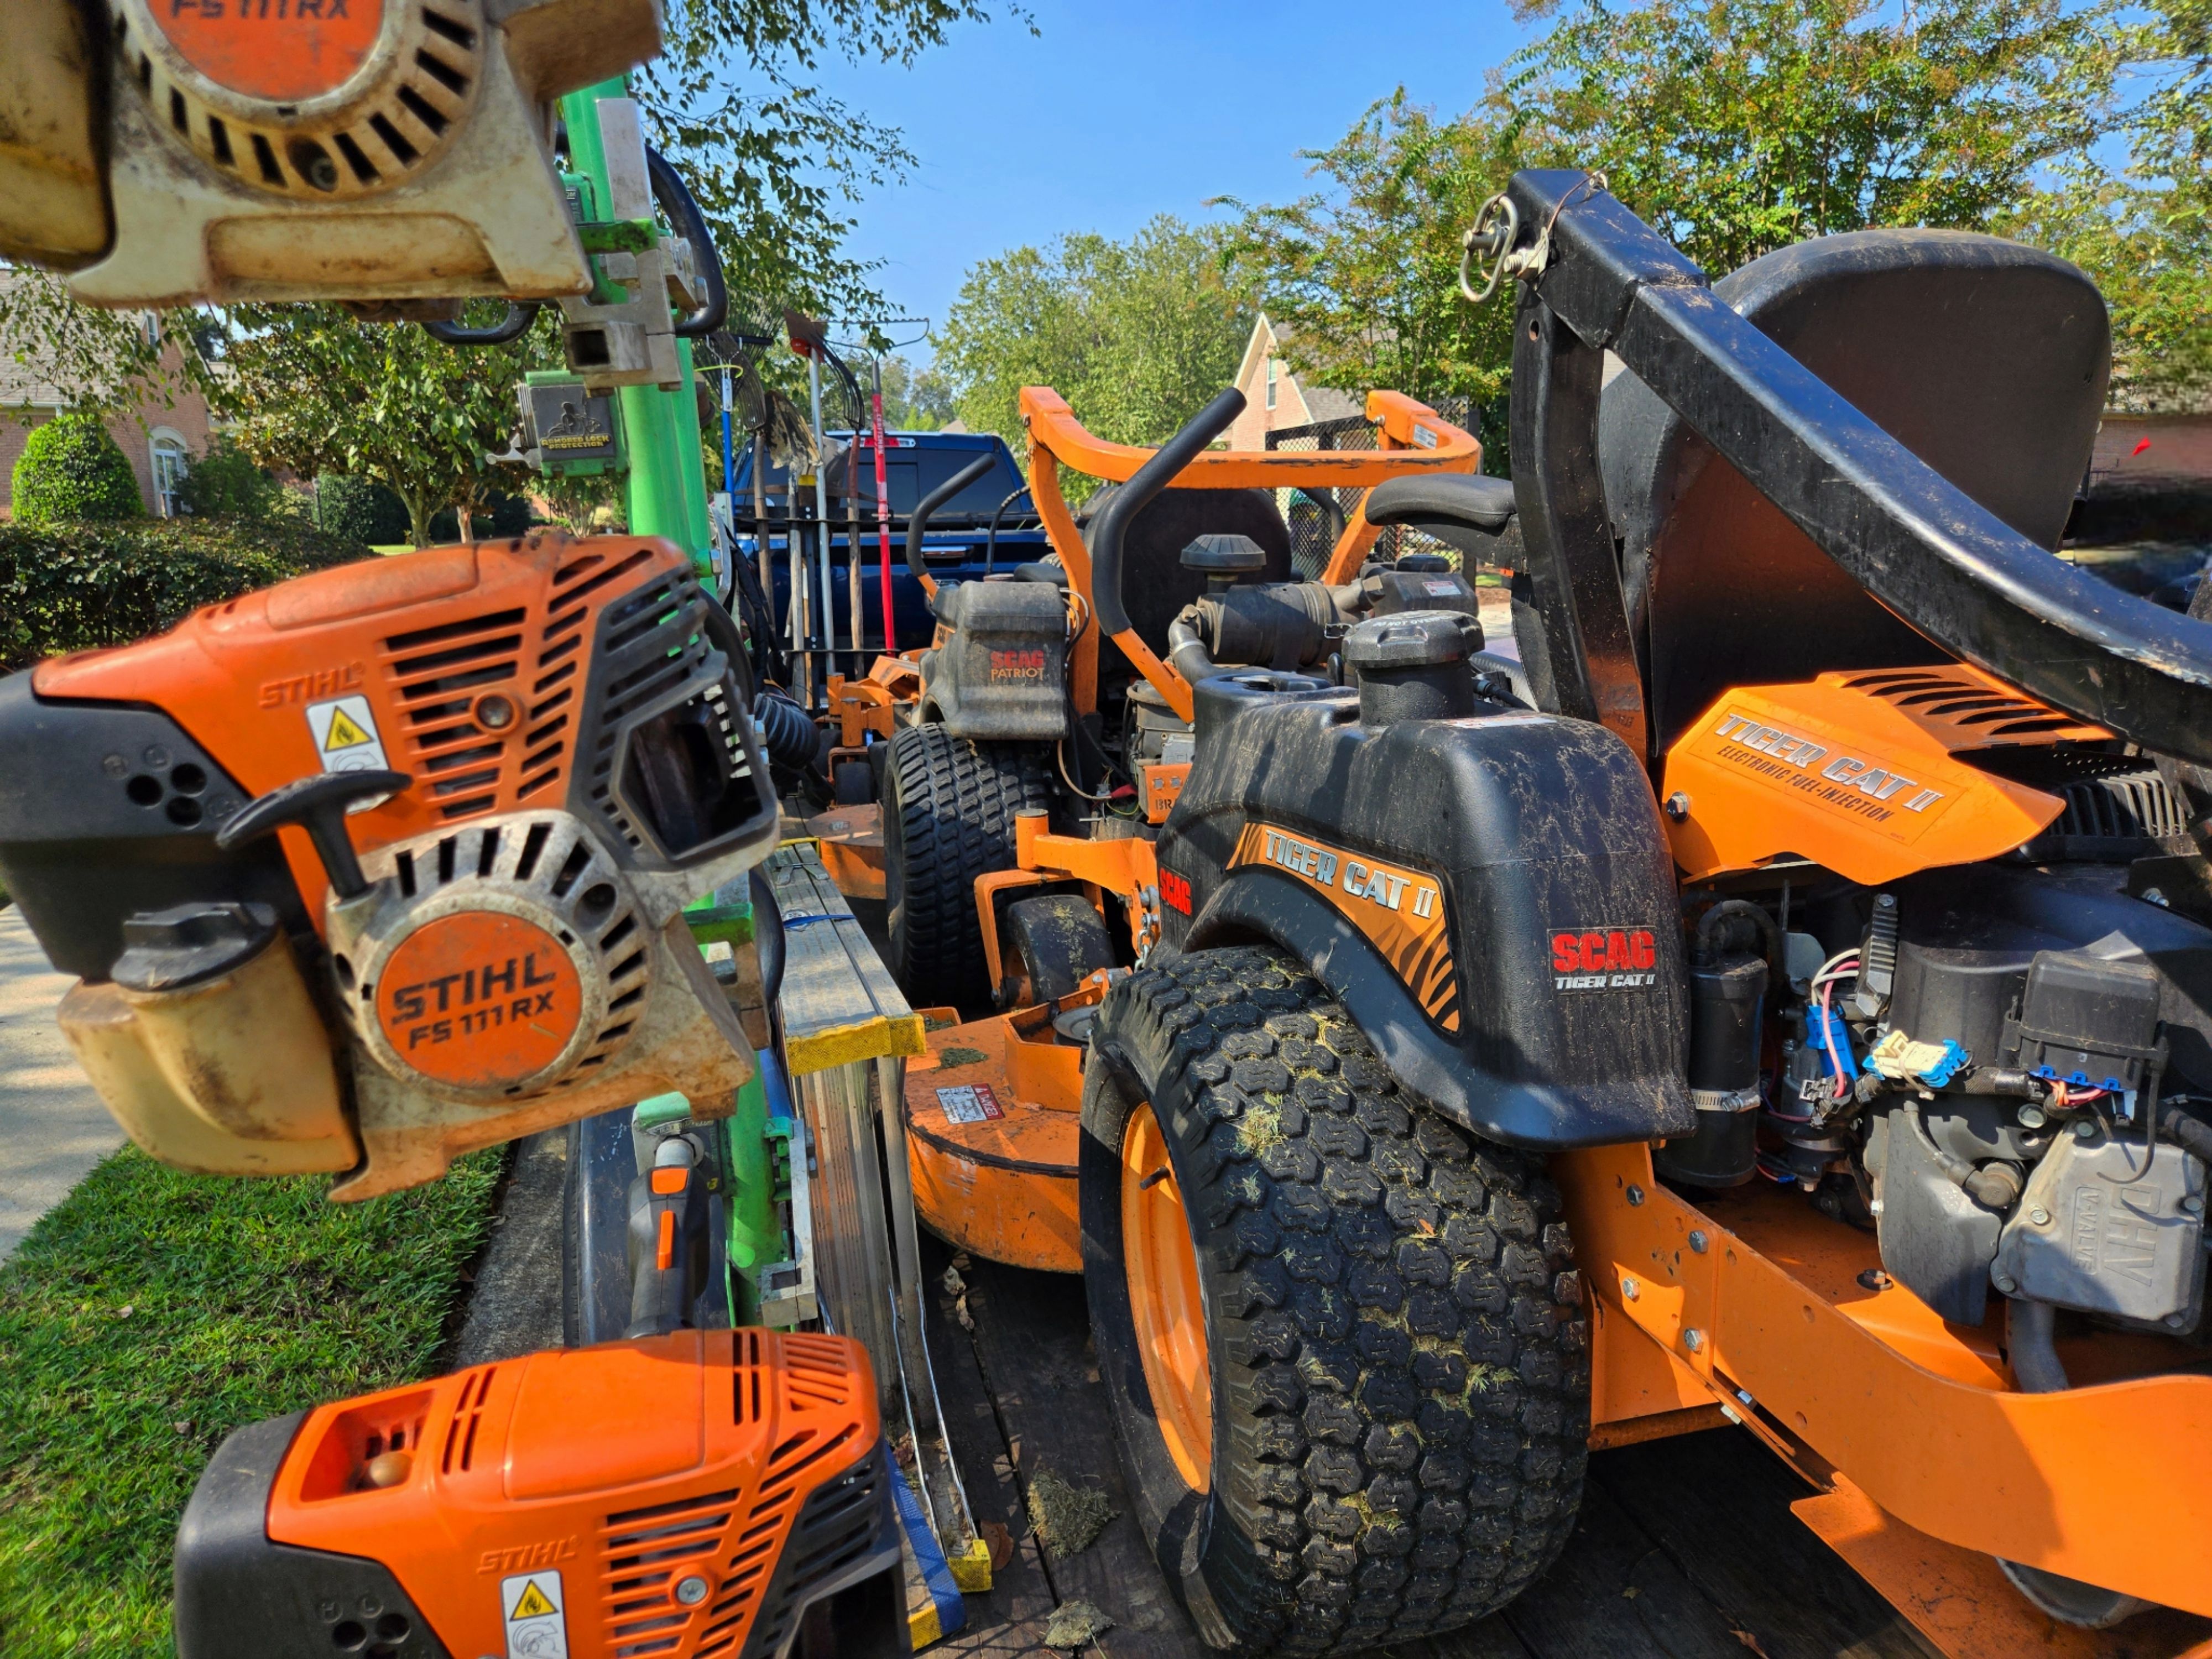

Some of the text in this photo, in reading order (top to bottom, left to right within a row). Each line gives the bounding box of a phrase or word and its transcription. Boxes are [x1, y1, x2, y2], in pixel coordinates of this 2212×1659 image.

[542, 436, 584, 446] ARMORED
[548, 441, 604, 450] PROTECTION
[990, 650, 1045, 669] SCAG
[991, 667, 1045, 681] PATRIOT
[259, 666, 363, 709] STIHL
[1715, 712, 1945, 813] TIGER CAT II
[1717, 745, 1895, 823] ELECTRONIC FUEL-INJECTION
[1160, 867, 1192, 916] SCAG
[1265, 828, 1437, 919] TIGER CAT II
[1552, 930, 1656, 972] SCAG
[391, 952, 556, 1026] STIHL
[1555, 974, 1656, 990] TIGER CAT II
[409, 990, 555, 1051] FS 111 RX
[979, 1094, 999, 1117] DANGER
[2075, 1193, 2099, 1271] V-VALVE
[2104, 1183, 2162, 1287] OHV
[476, 1538, 576, 1574] STIHL
